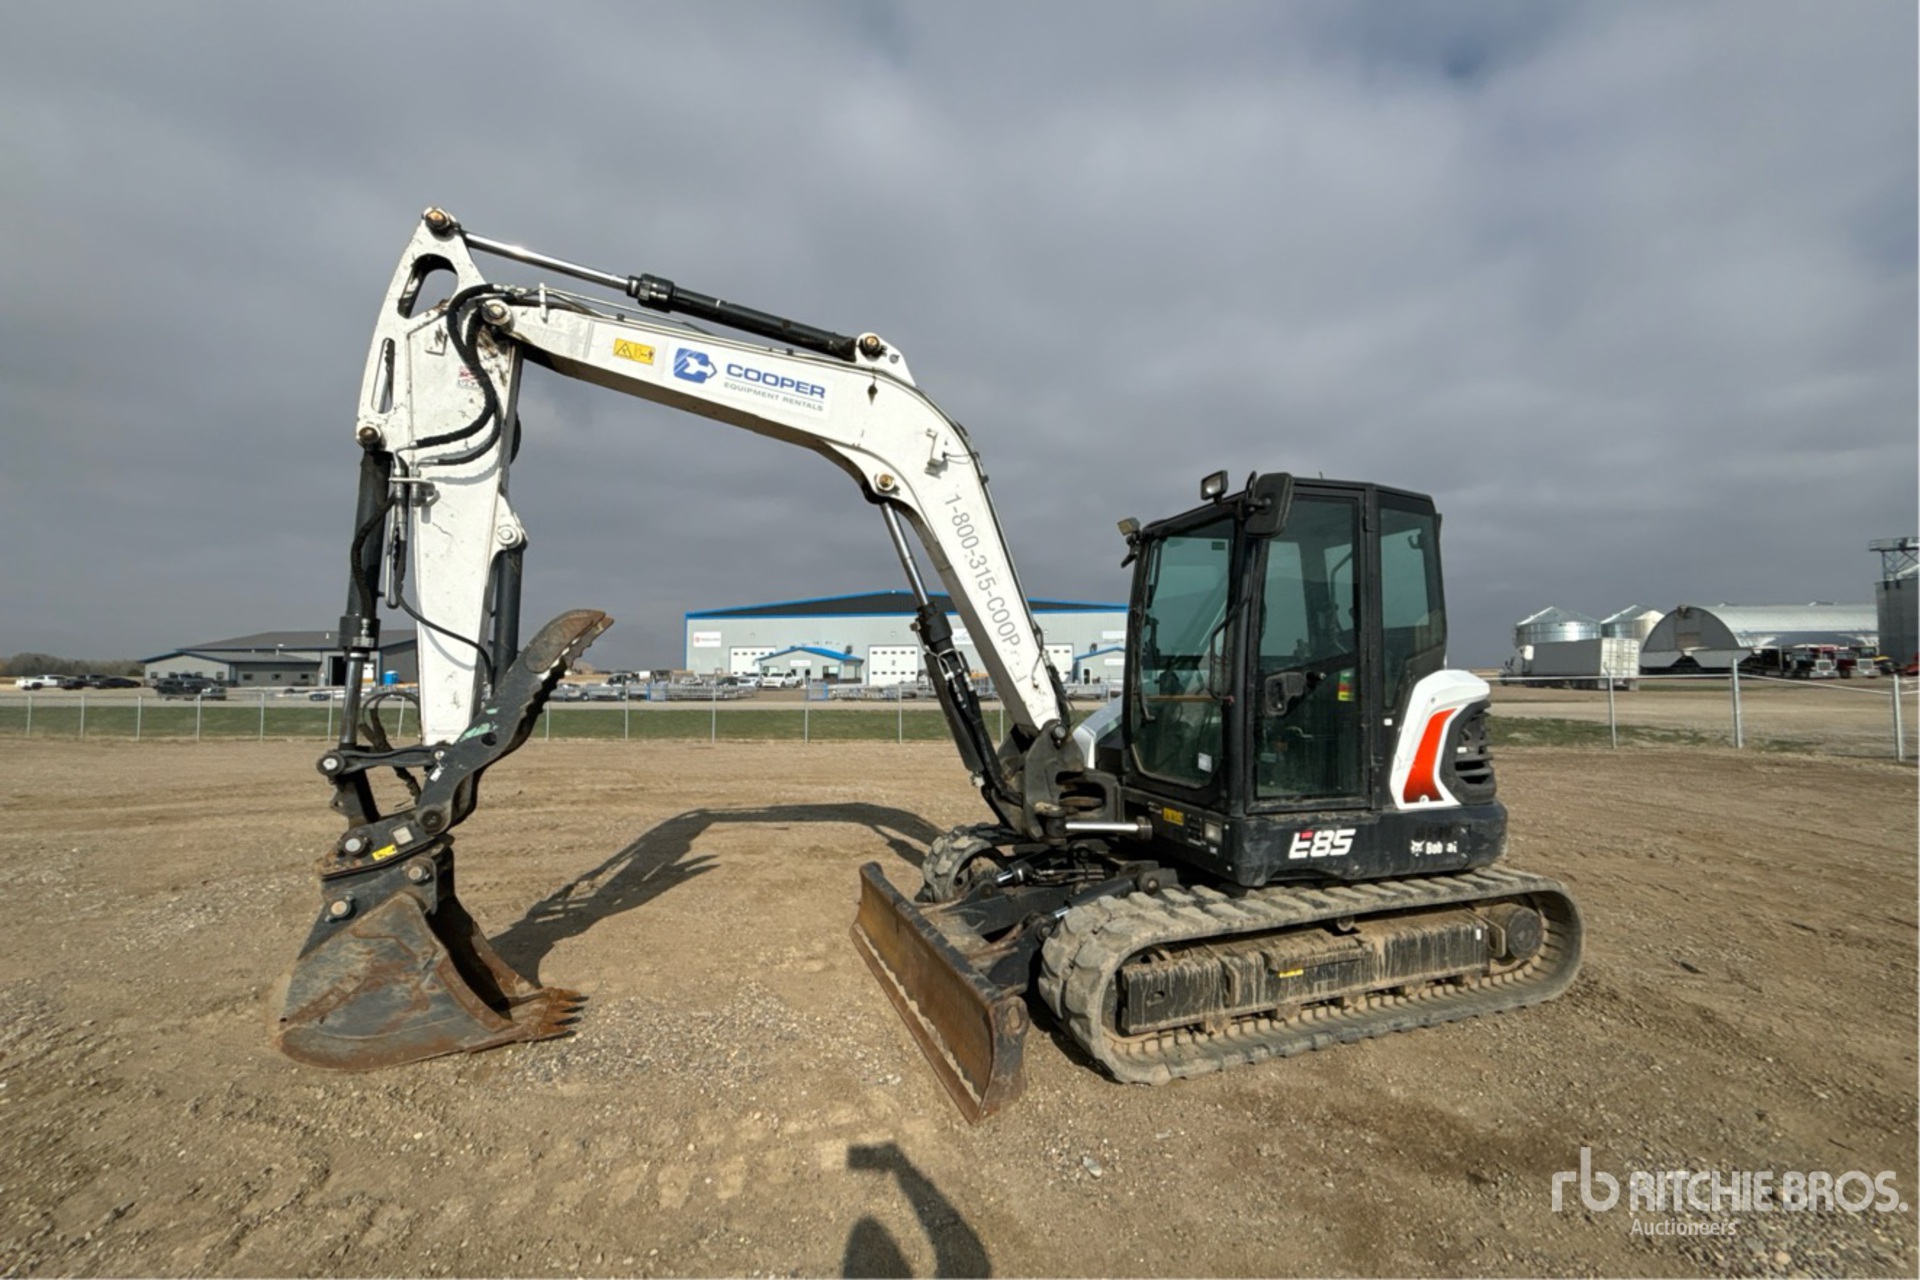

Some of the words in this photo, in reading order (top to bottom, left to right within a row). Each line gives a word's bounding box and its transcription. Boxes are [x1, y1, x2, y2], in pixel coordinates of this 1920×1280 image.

[724, 382, 779, 401] EQUIPMENT
[783, 396, 824, 412] RENTALS
[726, 363, 826, 399] COOPER
[945, 493, 1021, 646] 1-800-315-COOP
[1288, 829, 1357, 860] E85
